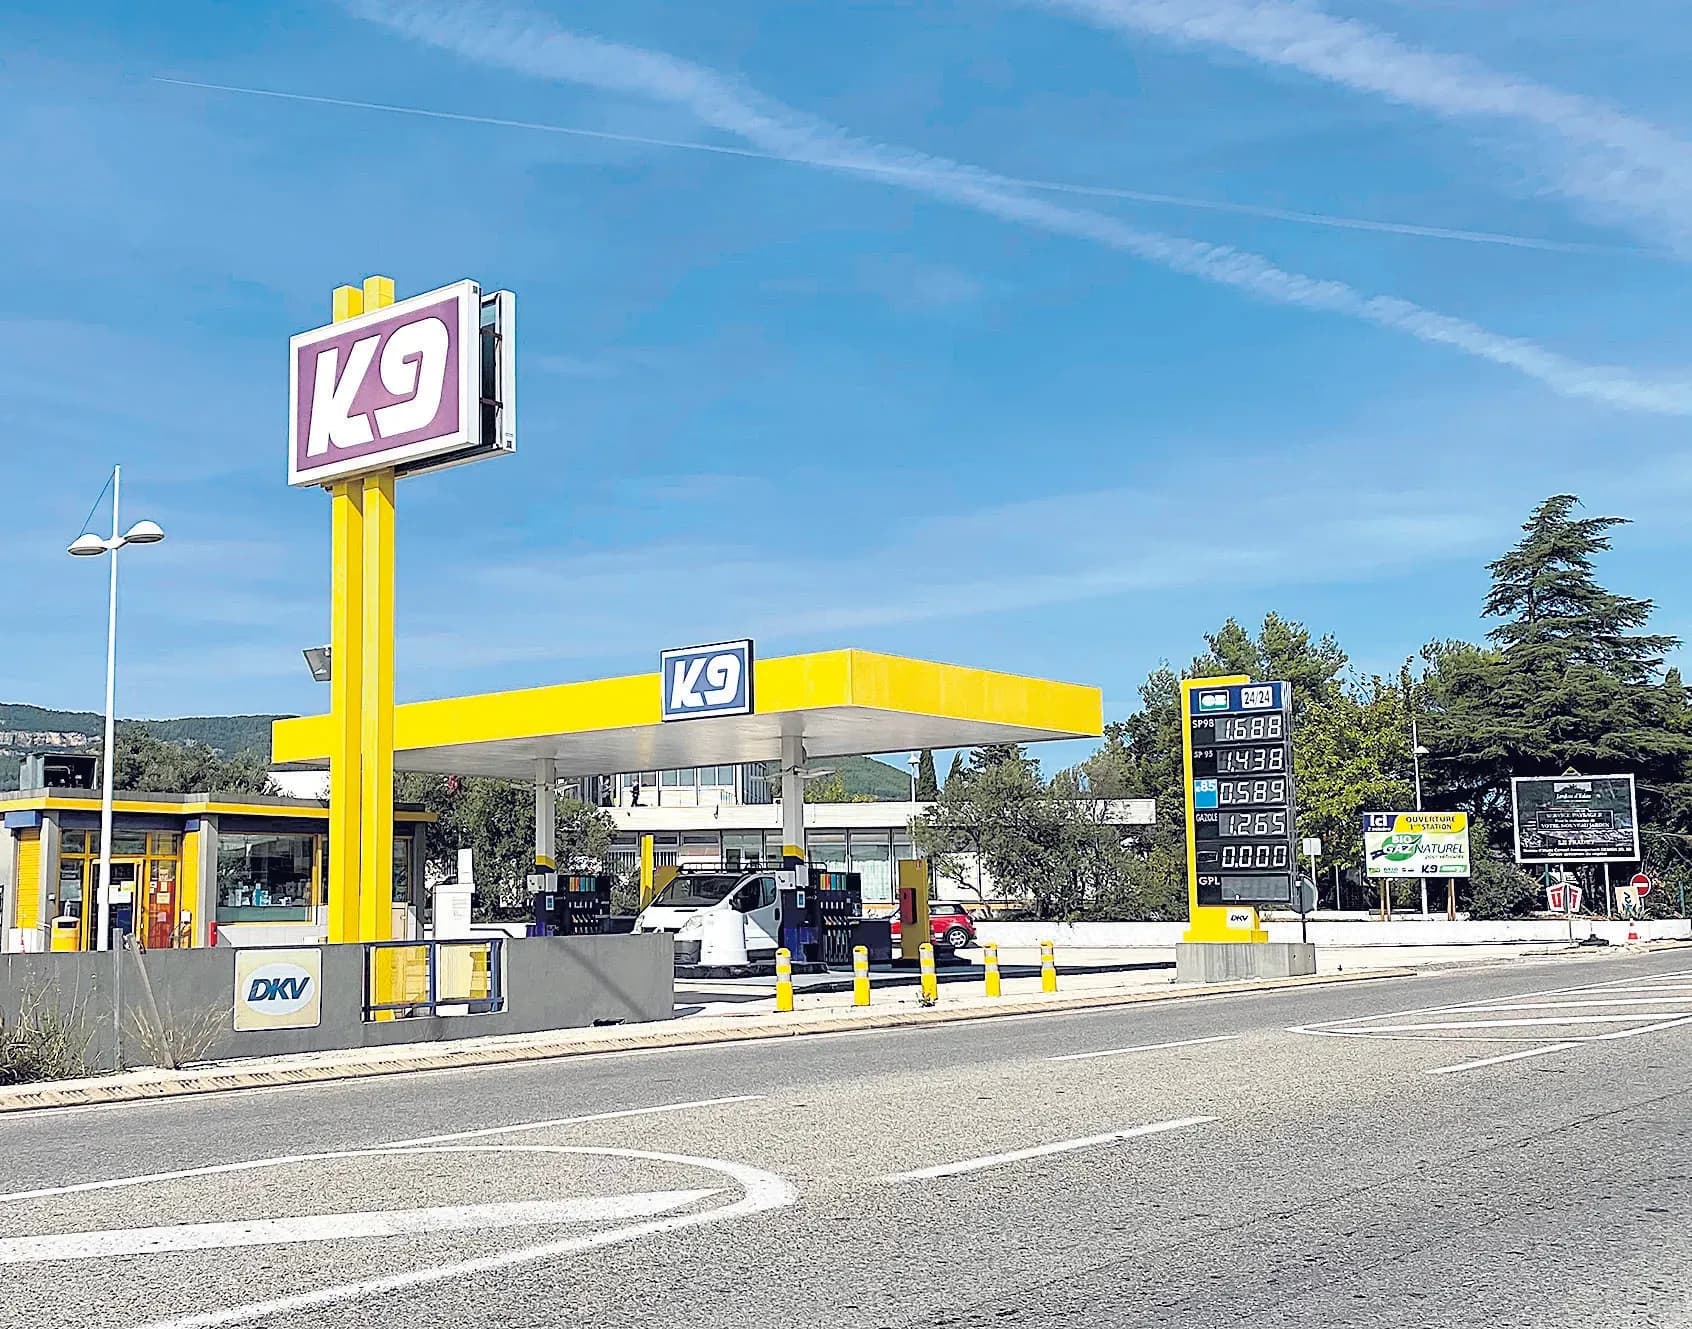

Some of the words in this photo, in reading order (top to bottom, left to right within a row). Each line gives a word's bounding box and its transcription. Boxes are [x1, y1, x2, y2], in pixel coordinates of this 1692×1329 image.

[307, 317, 450, 458] K9
[671, 654, 741, 709] K9
[1244, 690, 1270, 705] 24/24
[1192, 719, 1215, 729] SP98
[1196, 813, 1218, 822] GAZOLE
[1422, 823, 1452, 831] STATION
[1392, 835, 1413, 844] BIO
[1382, 845, 1412, 854] GAZ
[1414, 844, 1465, 854] NATUREL
[1421, 864, 1438, 874] K9
[1199, 877, 1220, 887] GPL
[247, 976, 311, 1002] DKV
